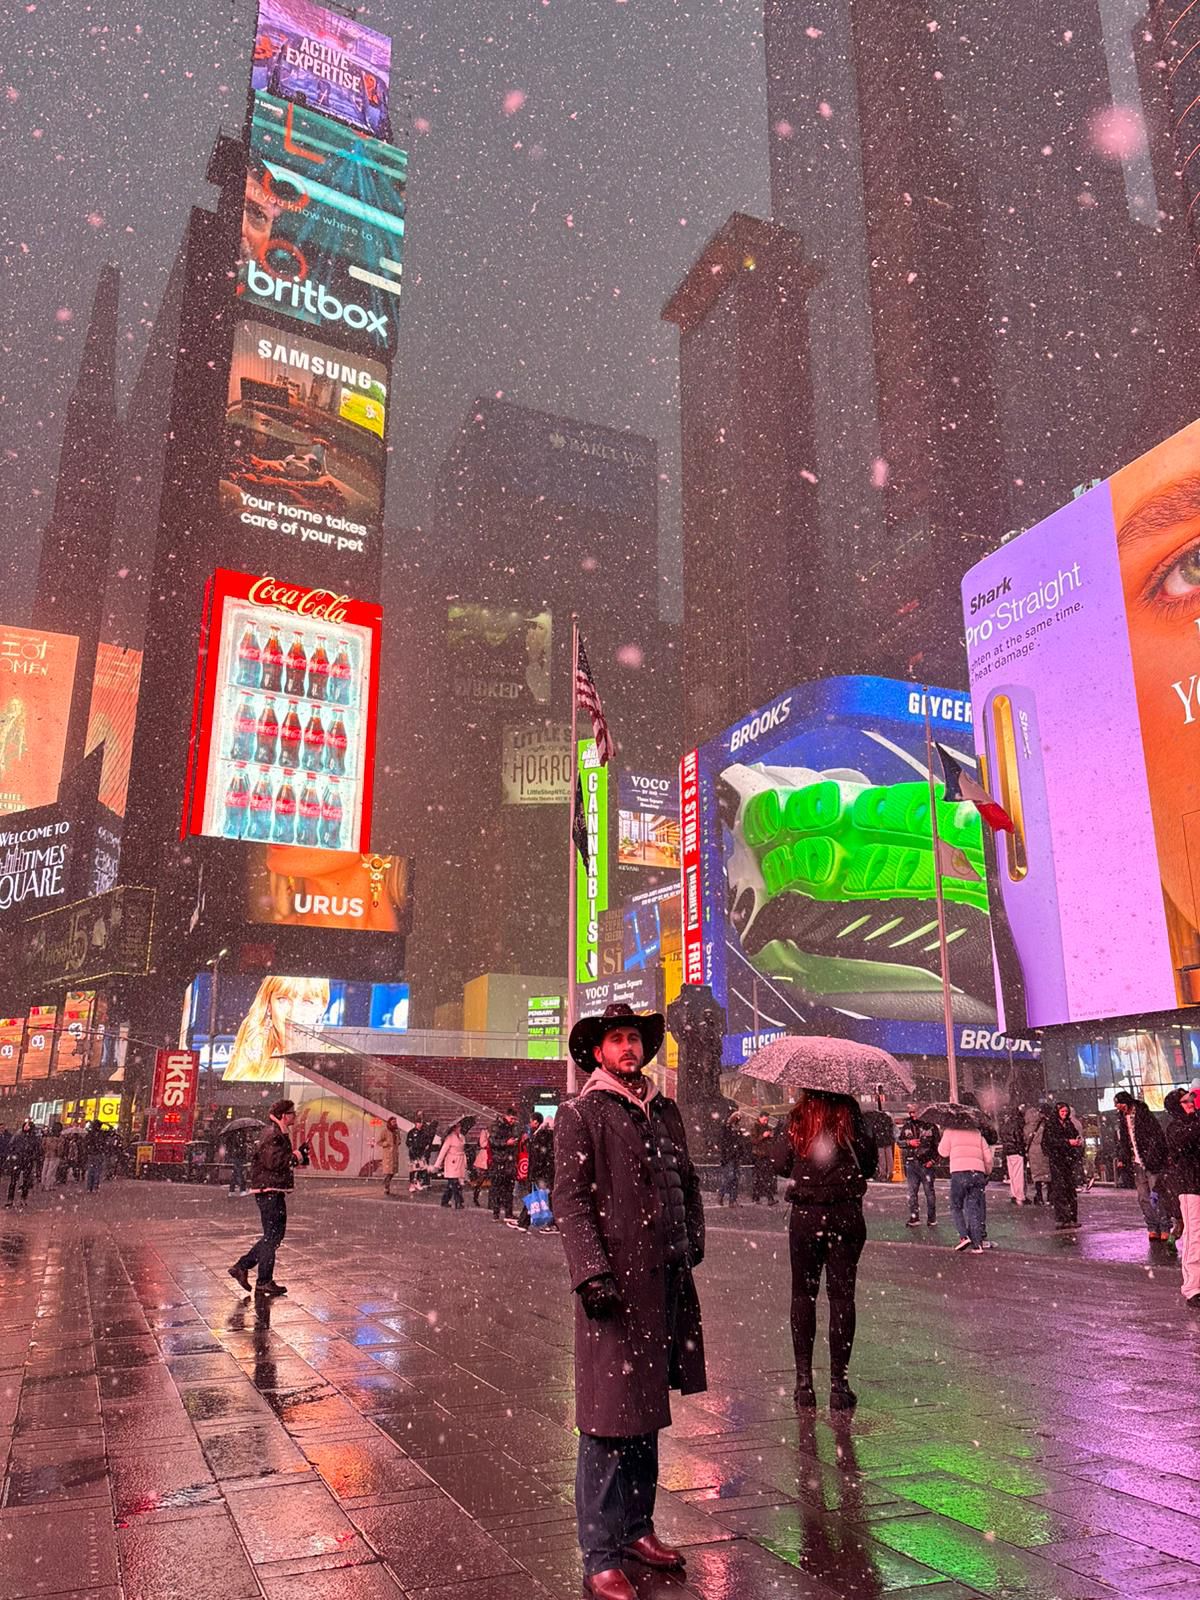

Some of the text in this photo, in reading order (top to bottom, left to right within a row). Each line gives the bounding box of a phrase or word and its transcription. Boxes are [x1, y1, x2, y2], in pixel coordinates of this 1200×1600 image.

[286, 48, 361, 92] EXPERTISE
[300, 38, 349, 71] ACTIVE
[261, 193, 284, 206] you
[288, 200, 319, 220] know
[323, 216, 358, 236] where
[361, 229, 373, 240] to
[247, 259, 388, 338] britbox
[258, 339, 371, 389] SAMSUNG
[240, 492, 367, 536] Your home takes
[240, 511, 364, 552] care of your pet
[248, 576, 353, 624] Coca-Cola
[970, 575, 1012, 616] Shark
[994, 561, 1083, 631] Straight
[993, 643, 1004, 656] at
[1005, 634, 1023, 649] the
[1024, 617, 1053, 638] same
[1055, 602, 1084, 624] time.
[975, 663, 992, 682] heat
[1171, 674, 1200, 724] Y
[730, 697, 792, 752] BROOKS
[512, 753, 572, 795] HORRO
[684, 751, 697, 856] HEY'S STORE
[0, 821, 70, 847] WELCOME TO
[23, 844, 67, 870] TIMES
[587, 773, 599, 943] CANNABIS
[294, 894, 365, 918] URUS
[688, 941, 701, 983] FREE
[163, 1053, 193, 1107] tkts
